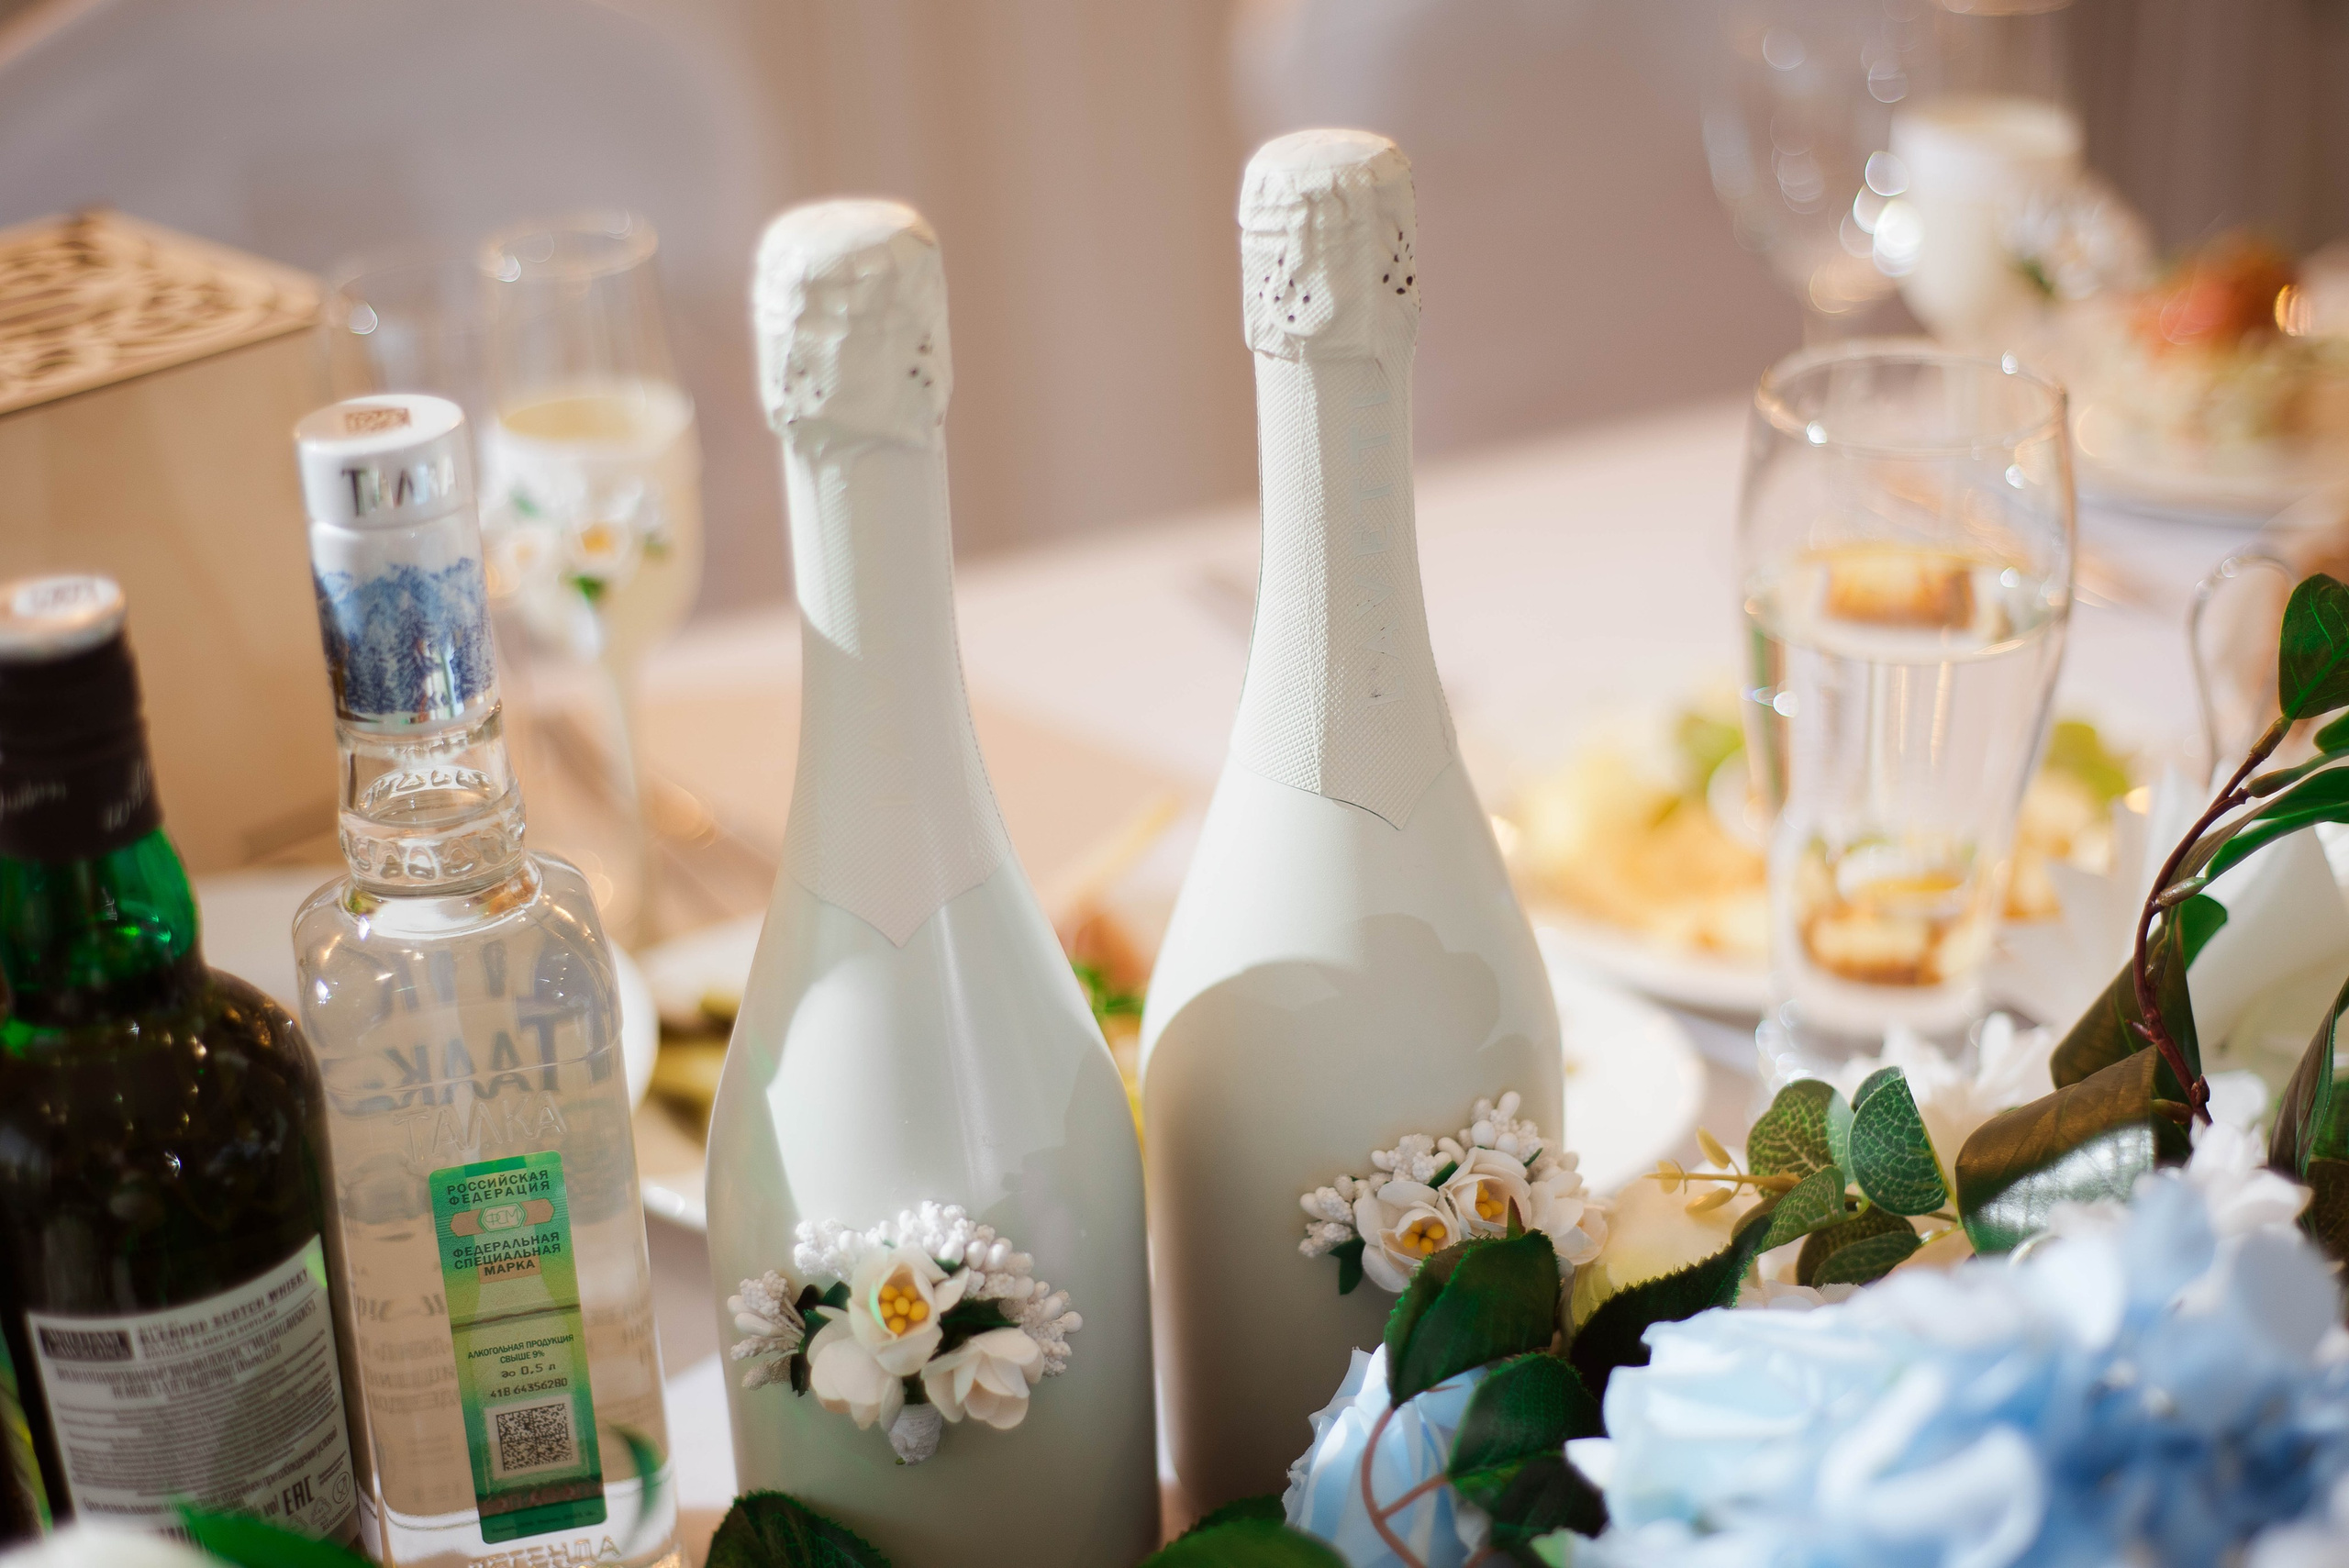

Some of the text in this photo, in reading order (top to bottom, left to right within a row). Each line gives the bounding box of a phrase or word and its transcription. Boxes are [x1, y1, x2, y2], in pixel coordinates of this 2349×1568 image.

[447, 1170, 549, 1195] РОССИЙСКАЯ
[449, 1180, 550, 1206] ФЕДЕРАЦИЯ
[453, 1231, 560, 1258] ФЕДЕРАЛЬНАЯ
[454, 1243, 561, 1270] СПЕЦИАЛЬНАЯ
[484, 1259, 535, 1275] МАРКА
[468, 1334, 574, 1359] АЛКОГОЛЬНАЯ ПРОДУКЦИЯ
[500, 1350, 545, 1363] СВЫШЕ 9%
